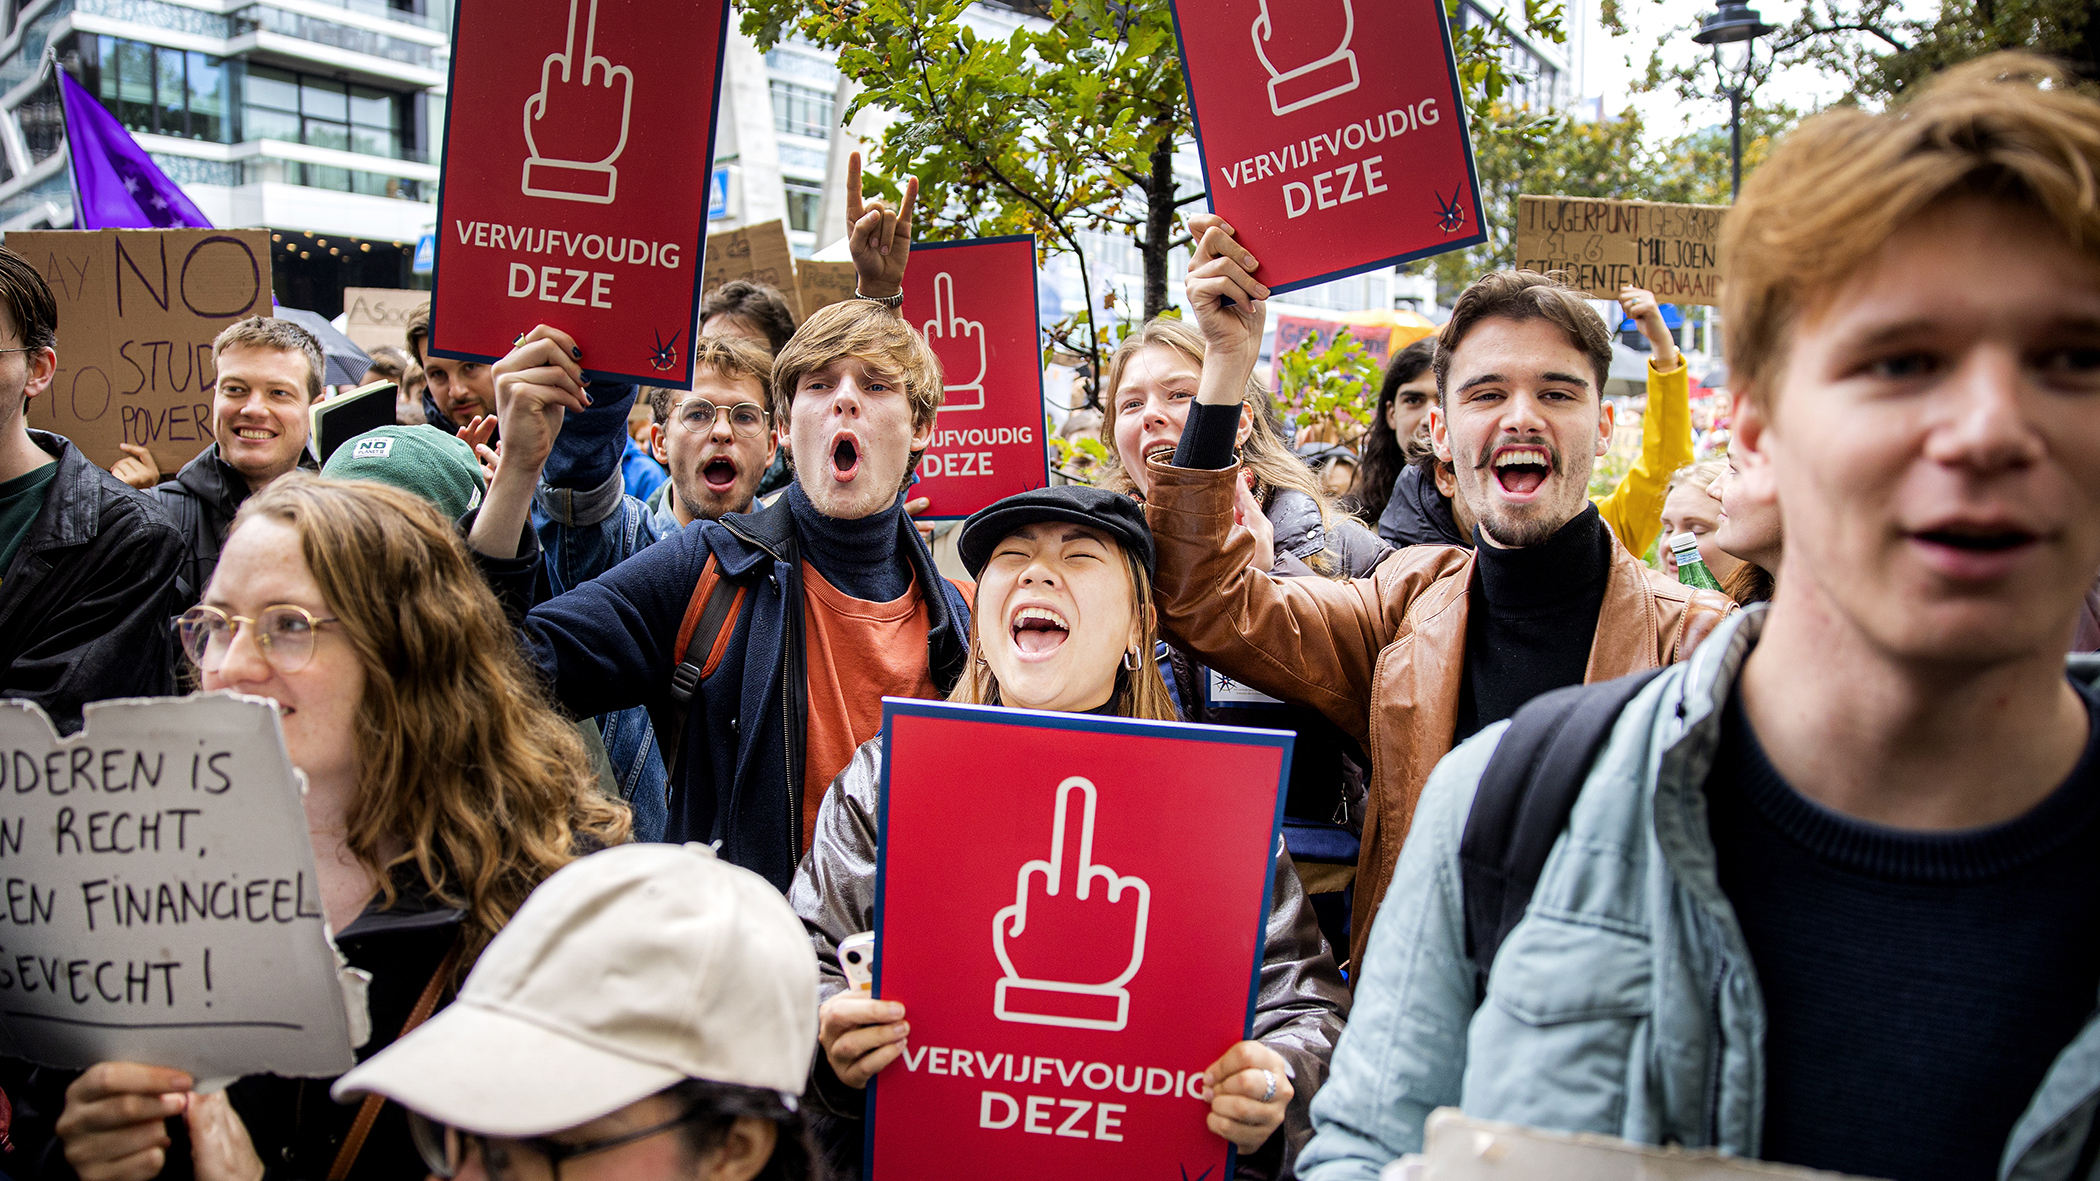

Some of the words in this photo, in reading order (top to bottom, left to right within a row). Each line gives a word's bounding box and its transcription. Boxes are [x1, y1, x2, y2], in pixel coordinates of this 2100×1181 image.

[1221, 98, 1440, 189] VERVIJFVOUDIG
[1282, 155, 1388, 219] DEZE
[456, 219, 680, 269] VERVIJFVOUDIG
[1637, 237, 1716, 269] MILJOEN
[22, 251, 90, 301] AY
[115, 234, 260, 318] NO
[507, 262, 615, 309] DEZE
[120, 340, 216, 395] STUD
[121, 404, 214, 446] POVER
[931, 427, 1033, 447] IJFVOUDIG
[922, 452, 994, 478] DEZE
[0, 878, 55, 925] EN
[979, 1090, 1127, 1143] DEZE
